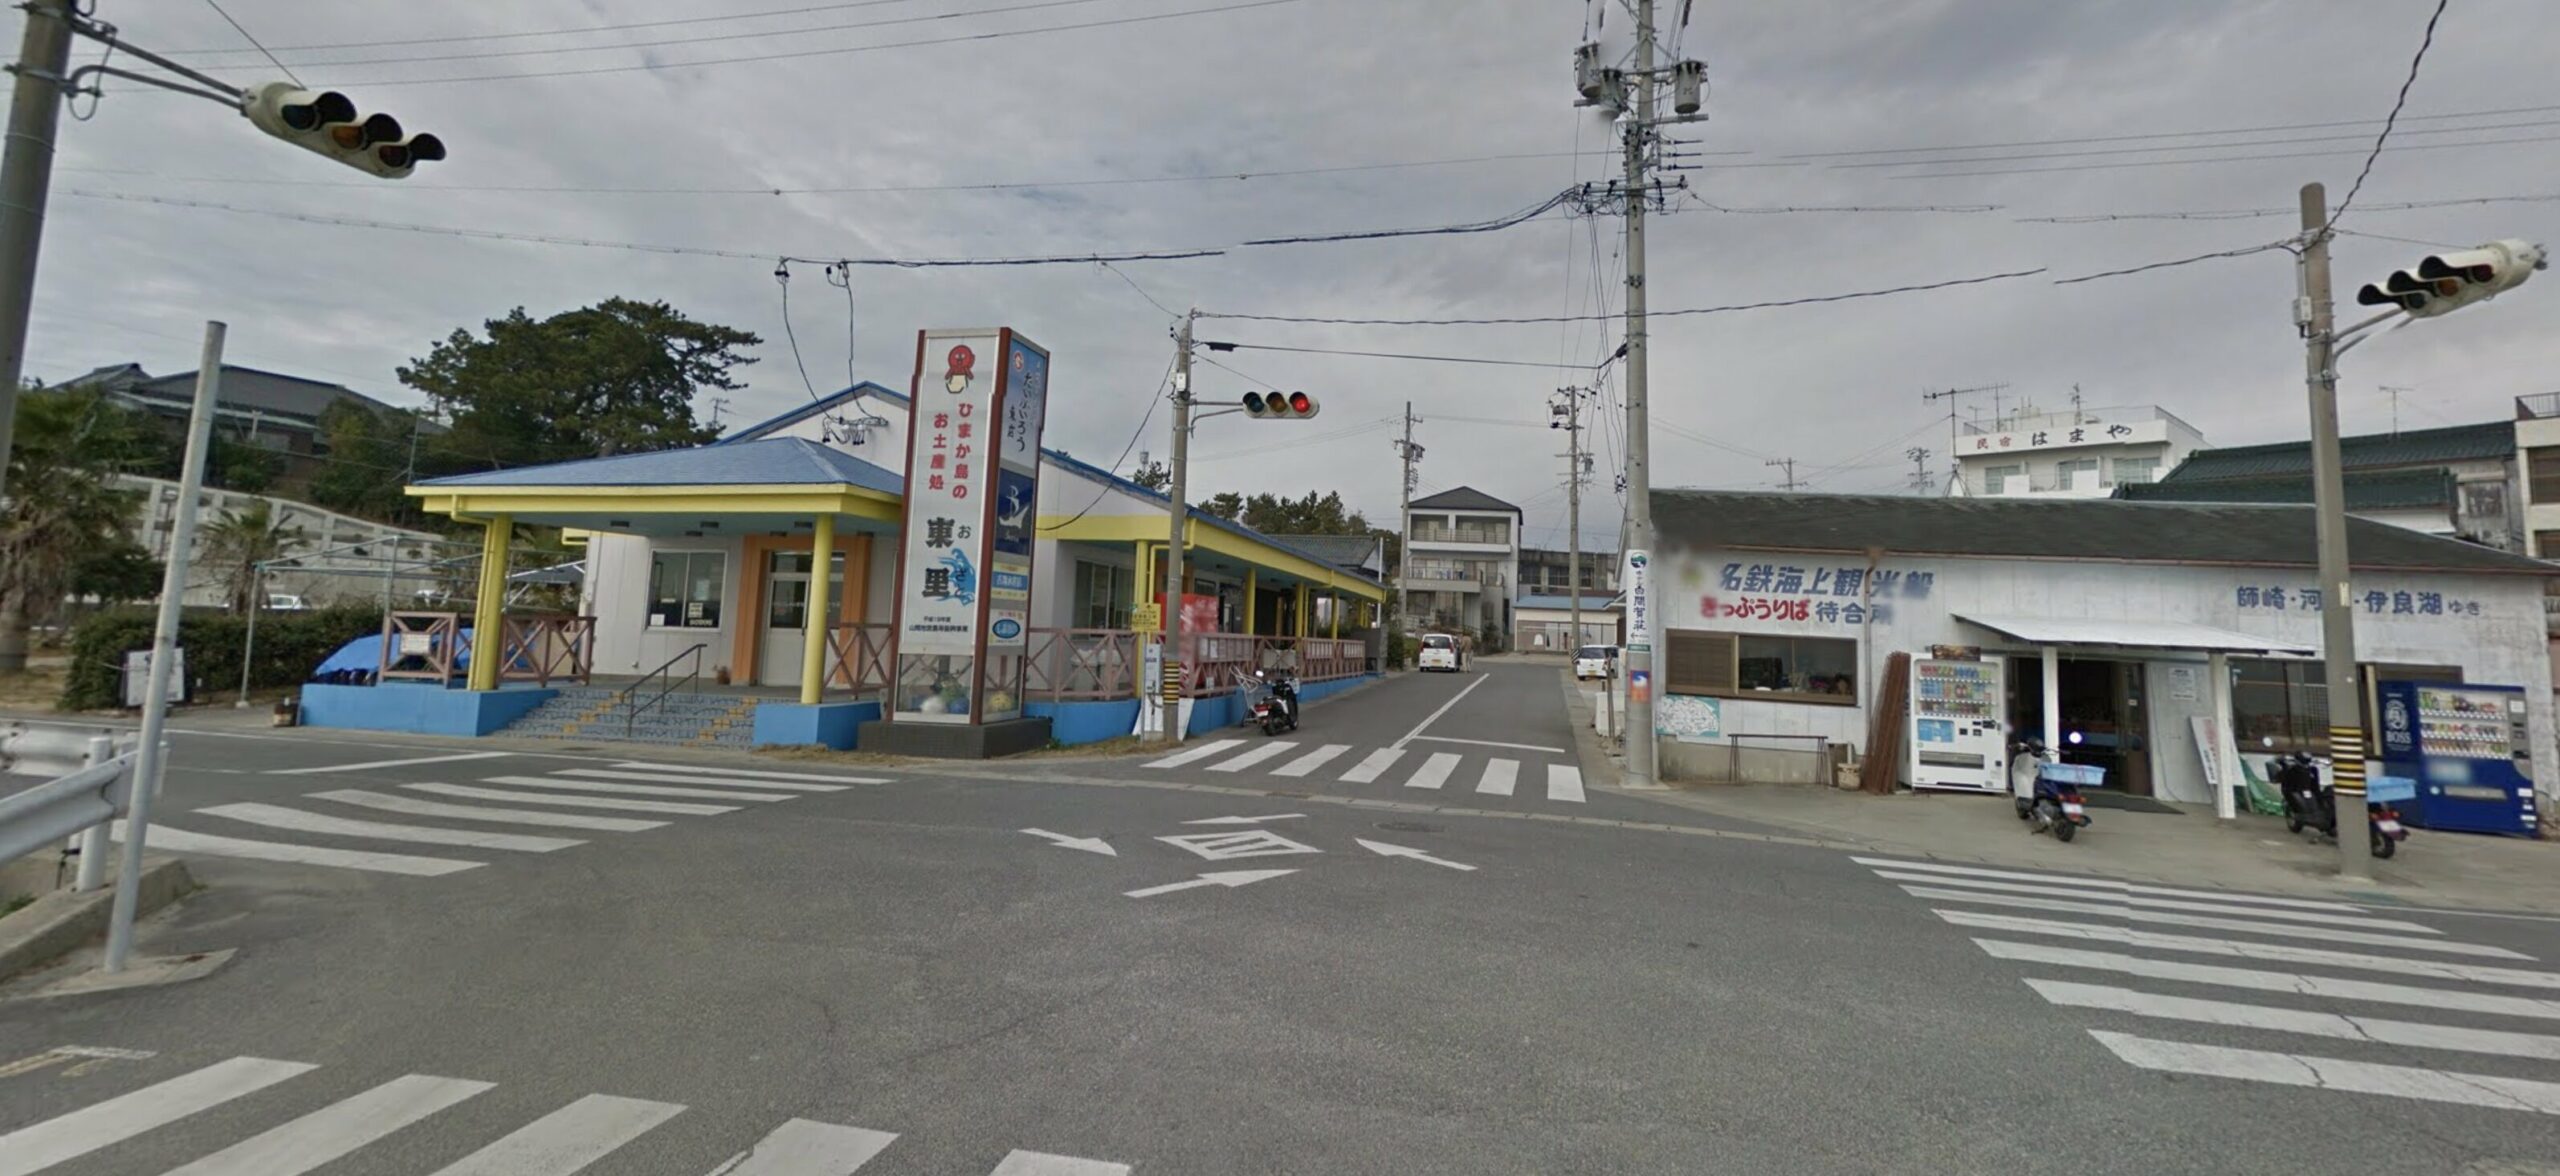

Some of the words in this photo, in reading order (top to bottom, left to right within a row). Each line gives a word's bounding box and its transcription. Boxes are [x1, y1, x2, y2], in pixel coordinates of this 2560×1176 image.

[928, 413, 949, 491] お土産処
[952, 403, 974, 499] ひまか島の
[1976, 436, 2012, 450] 民宿
[2032, 424, 2132, 446] はまや
[922, 517, 955, 597] 東里
[1720, 562, 1934, 599] 名鉄海上観光船
[1700, 596, 1811, 621] きっぷうりば
[1815, 602, 1893, 625] 待合所
[2386, 730, 2412, 744] BOSS
